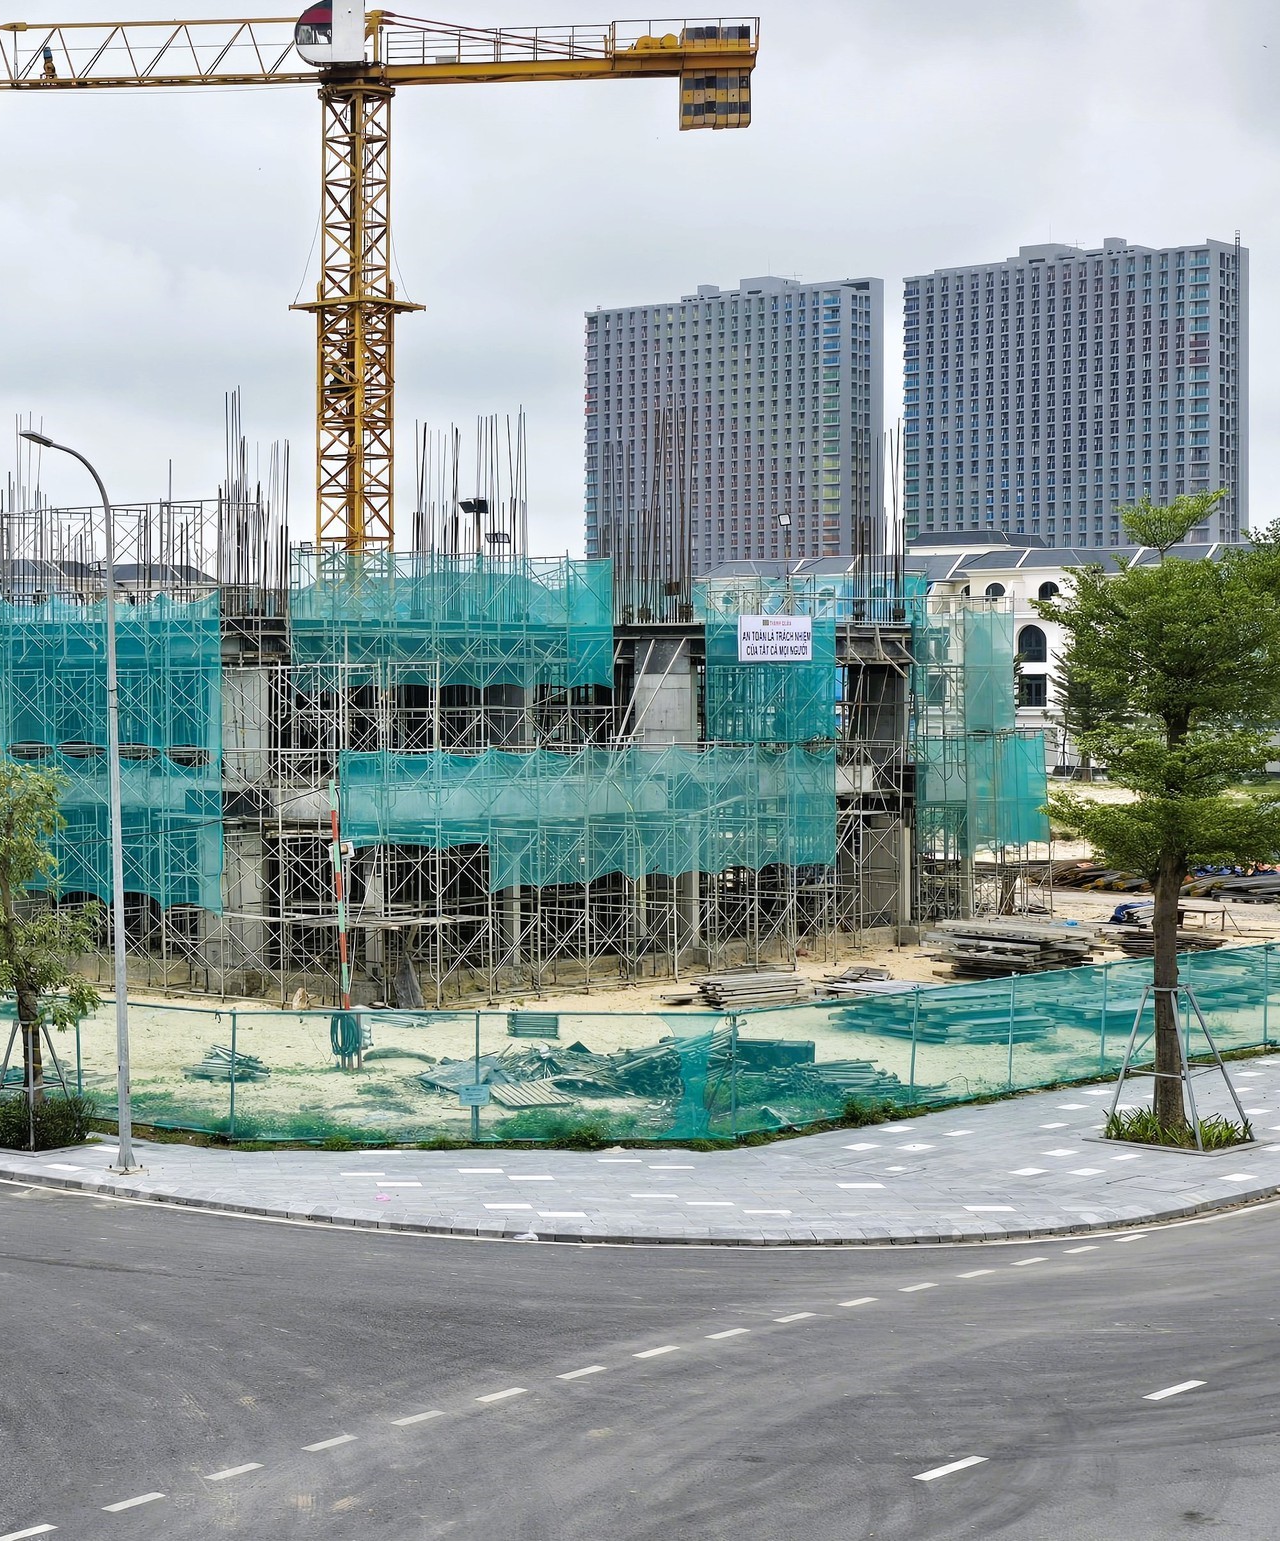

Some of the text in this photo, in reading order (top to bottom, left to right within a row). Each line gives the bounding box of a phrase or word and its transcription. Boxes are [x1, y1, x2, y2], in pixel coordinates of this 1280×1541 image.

[742, 631, 751, 641] AN
[752, 629, 767, 641] TOÀN
[768, 629, 774, 641] LÀ
[776, 629, 794, 641] TRÁCH
[746, 643, 758, 655] CỦA
[779, 645, 789, 658] MỌI
